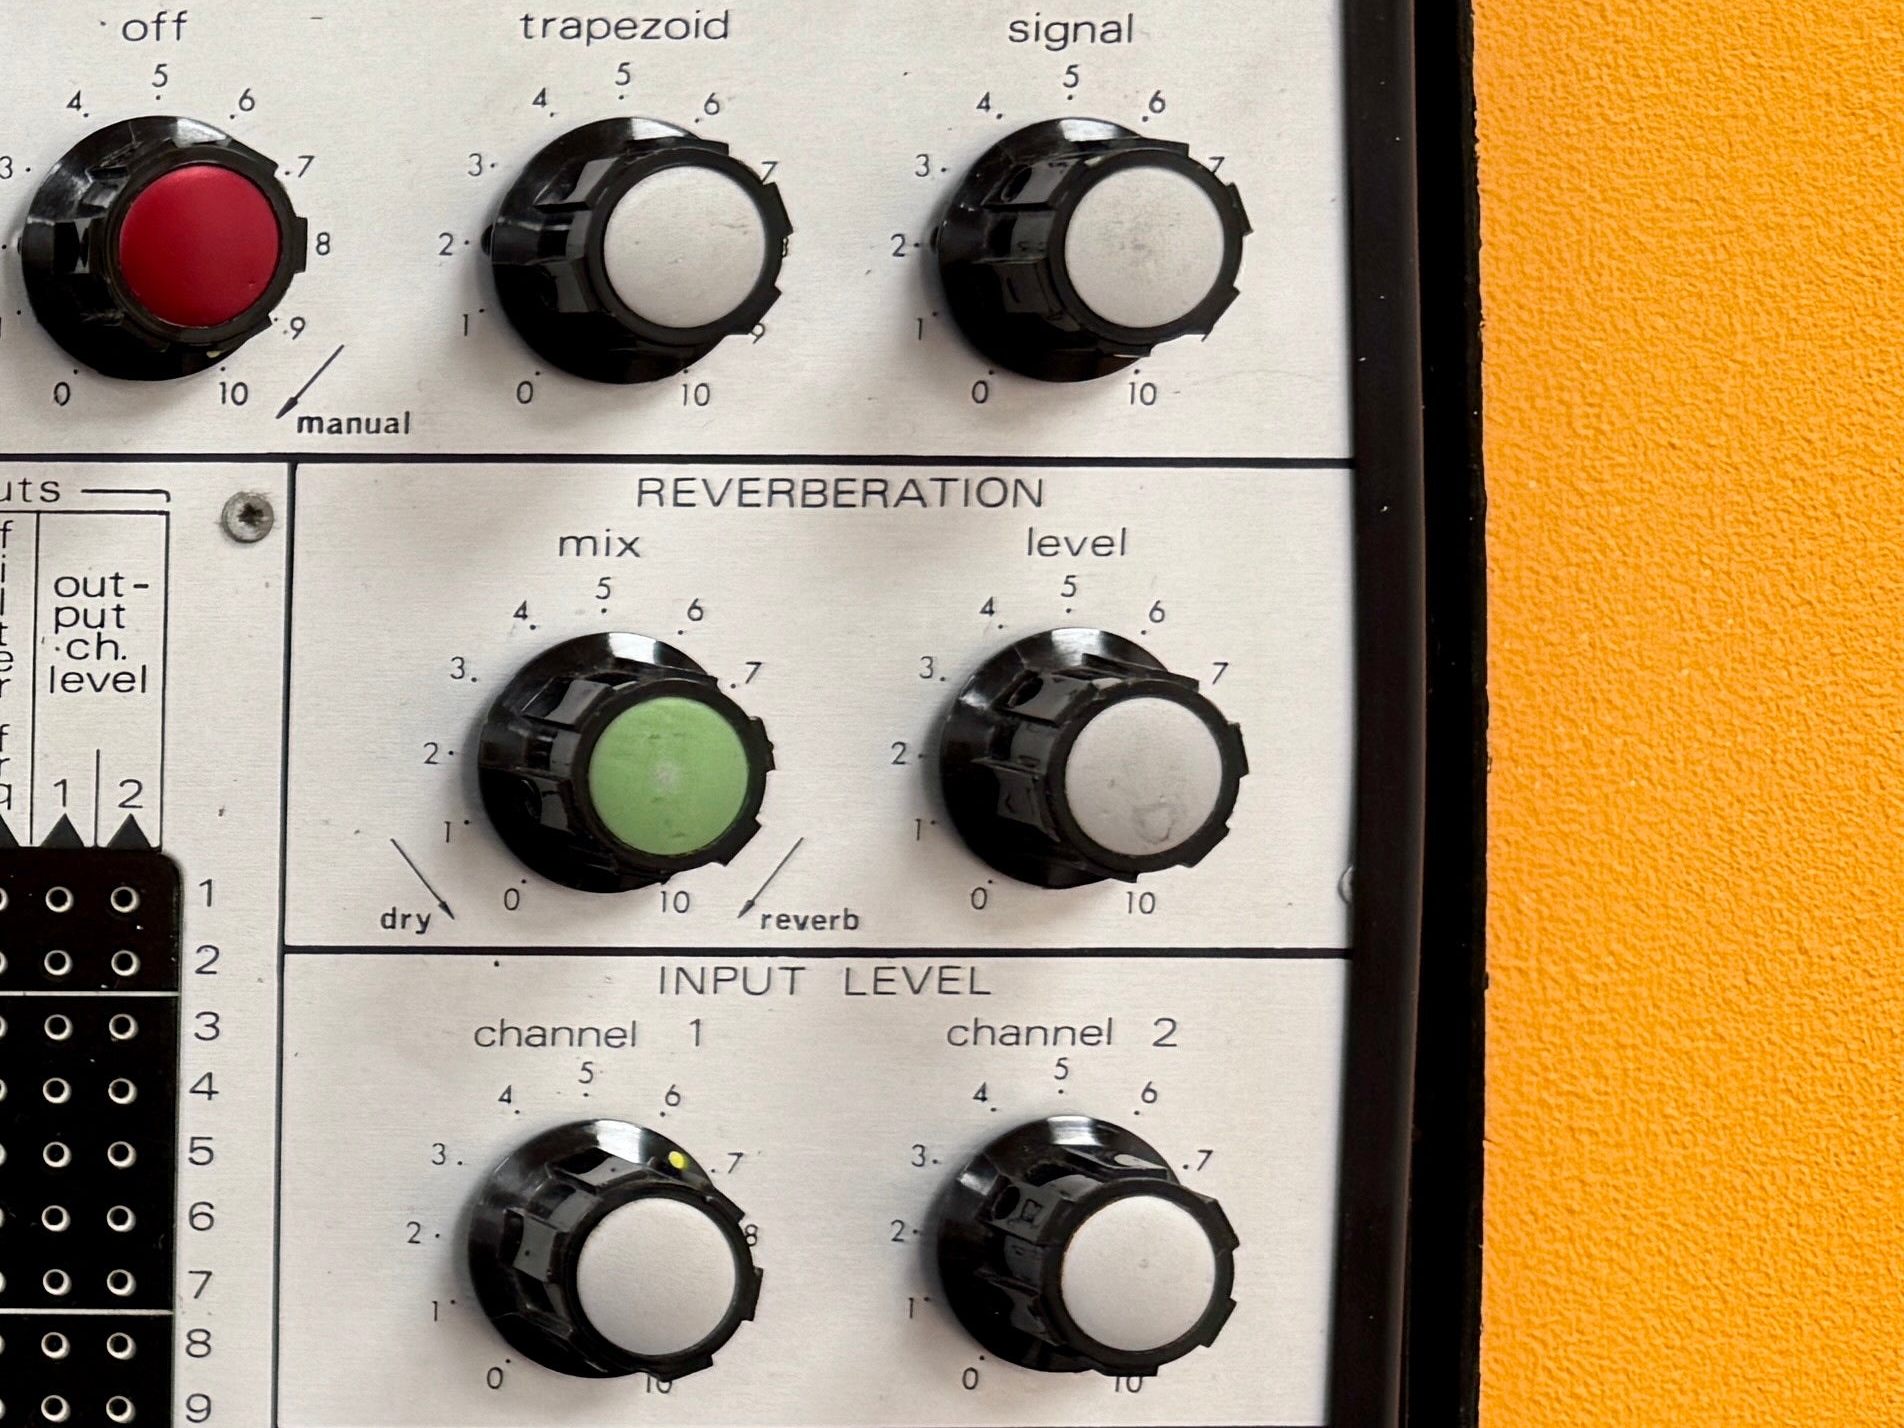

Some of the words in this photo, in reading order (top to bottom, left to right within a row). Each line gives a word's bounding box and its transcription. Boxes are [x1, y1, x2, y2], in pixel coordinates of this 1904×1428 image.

[121, 9, 188, 42] off
[519, 9, 730, 47] trapezoid
[1008, 11, 1134, 52] signal
[296, 410, 411, 435] manual
[637, 476, 1043, 509] REVERBERATION
[558, 528, 641, 558] mix
[380, 906, 432, 936] dry
[760, 907, 860, 932] reverb
[659, 965, 807, 997] INPUT
[844, 964, 992, 996] LEVEL
[473, 1017, 637, 1049] channel
[689, 1018, 701, 1047] 1
[188, 1071, 220, 1101] 4
